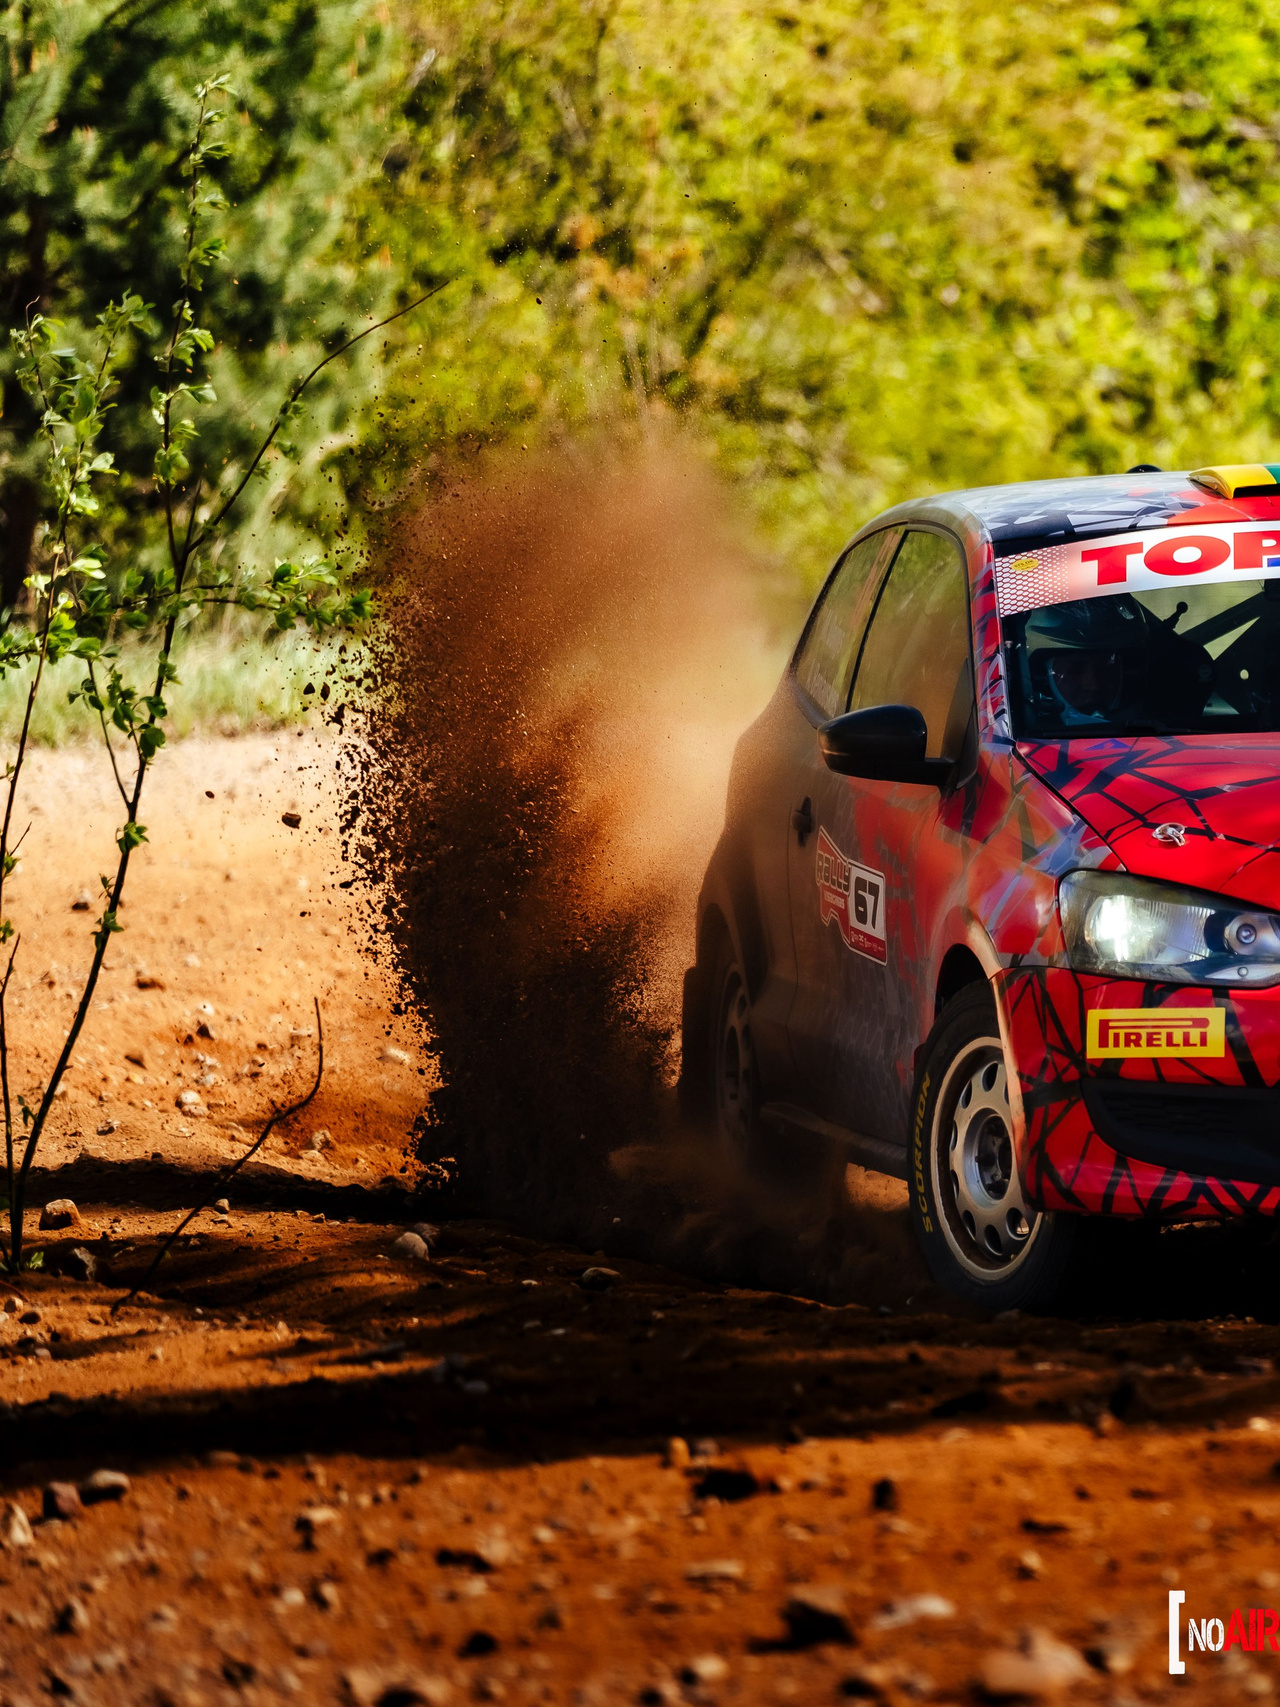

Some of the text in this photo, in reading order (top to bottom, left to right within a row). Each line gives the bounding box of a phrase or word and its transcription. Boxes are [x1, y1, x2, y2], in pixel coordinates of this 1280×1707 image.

[854, 876, 880, 930] 67
[1098, 1018, 1210, 1049] PIRELLI
[914, 1071, 933, 1234] SCORPION
